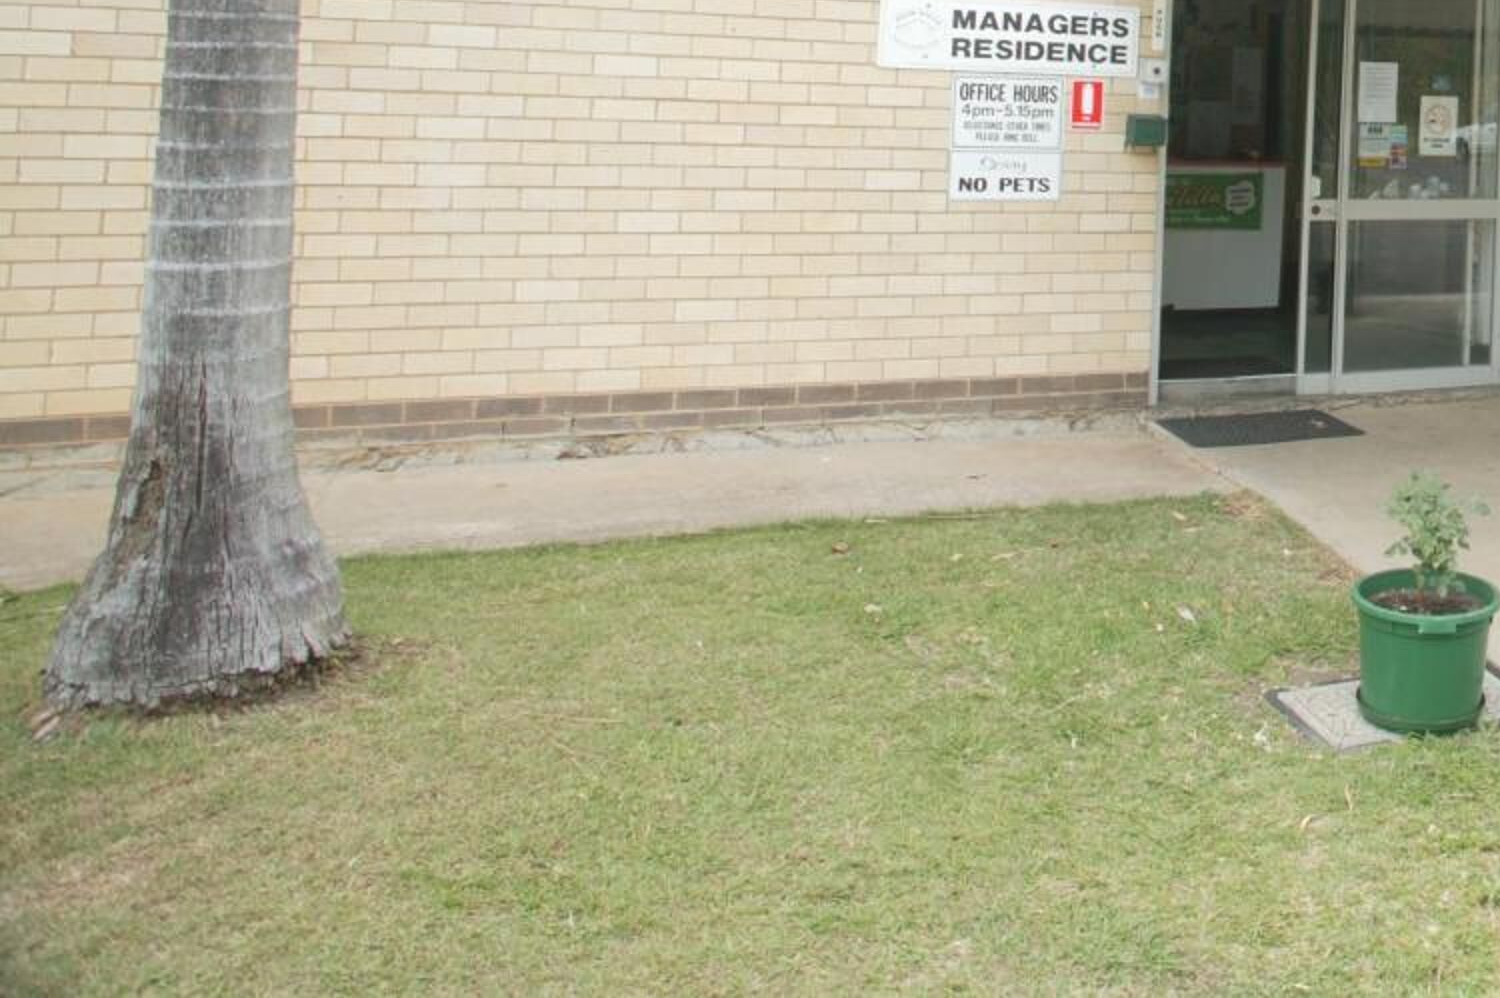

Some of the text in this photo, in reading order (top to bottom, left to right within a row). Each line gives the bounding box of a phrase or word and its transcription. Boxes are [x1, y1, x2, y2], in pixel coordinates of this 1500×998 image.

[952, 9, 1129, 38] MANAGERS
[951, 37, 1128, 64] RESIDENCE
[959, 83, 1059, 103] OFFICE HOURS
[958, 177, 1051, 193] NO PETS
